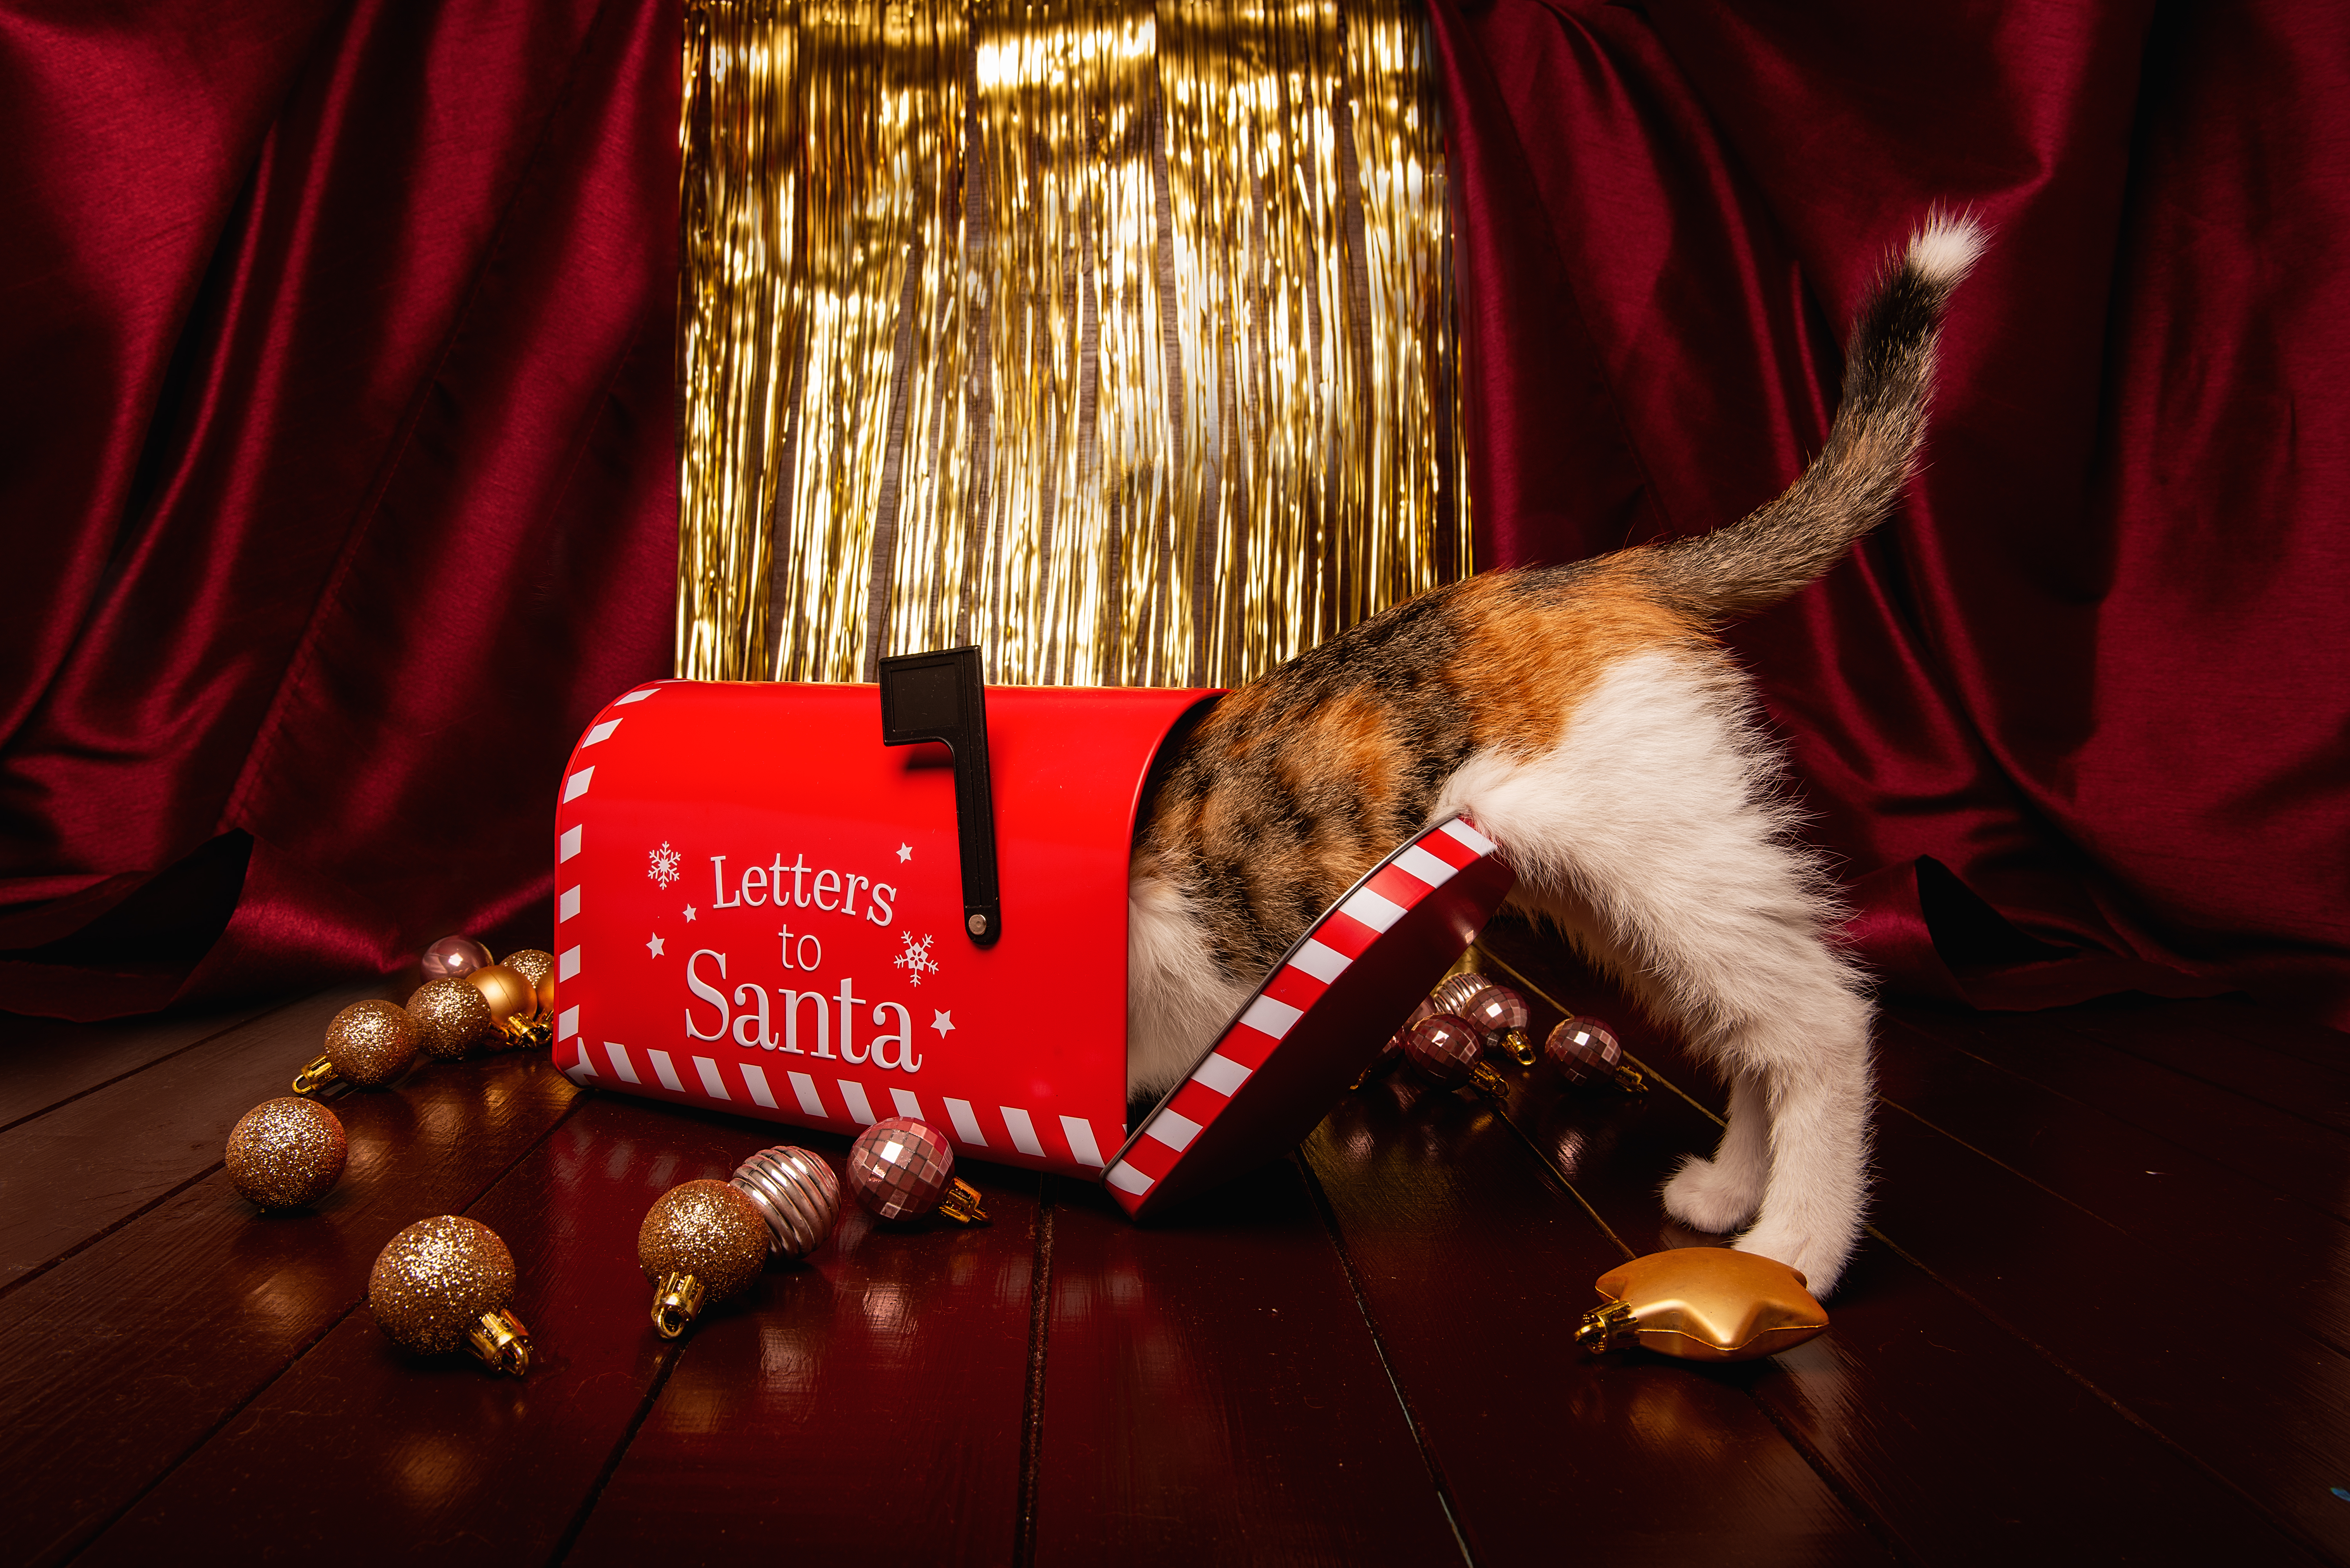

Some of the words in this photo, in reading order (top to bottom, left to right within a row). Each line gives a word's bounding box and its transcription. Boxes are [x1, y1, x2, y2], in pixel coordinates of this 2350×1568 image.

[710, 853, 897, 926] Letters
[778, 924, 821, 971] to
[685, 949, 922, 1073] Santa
